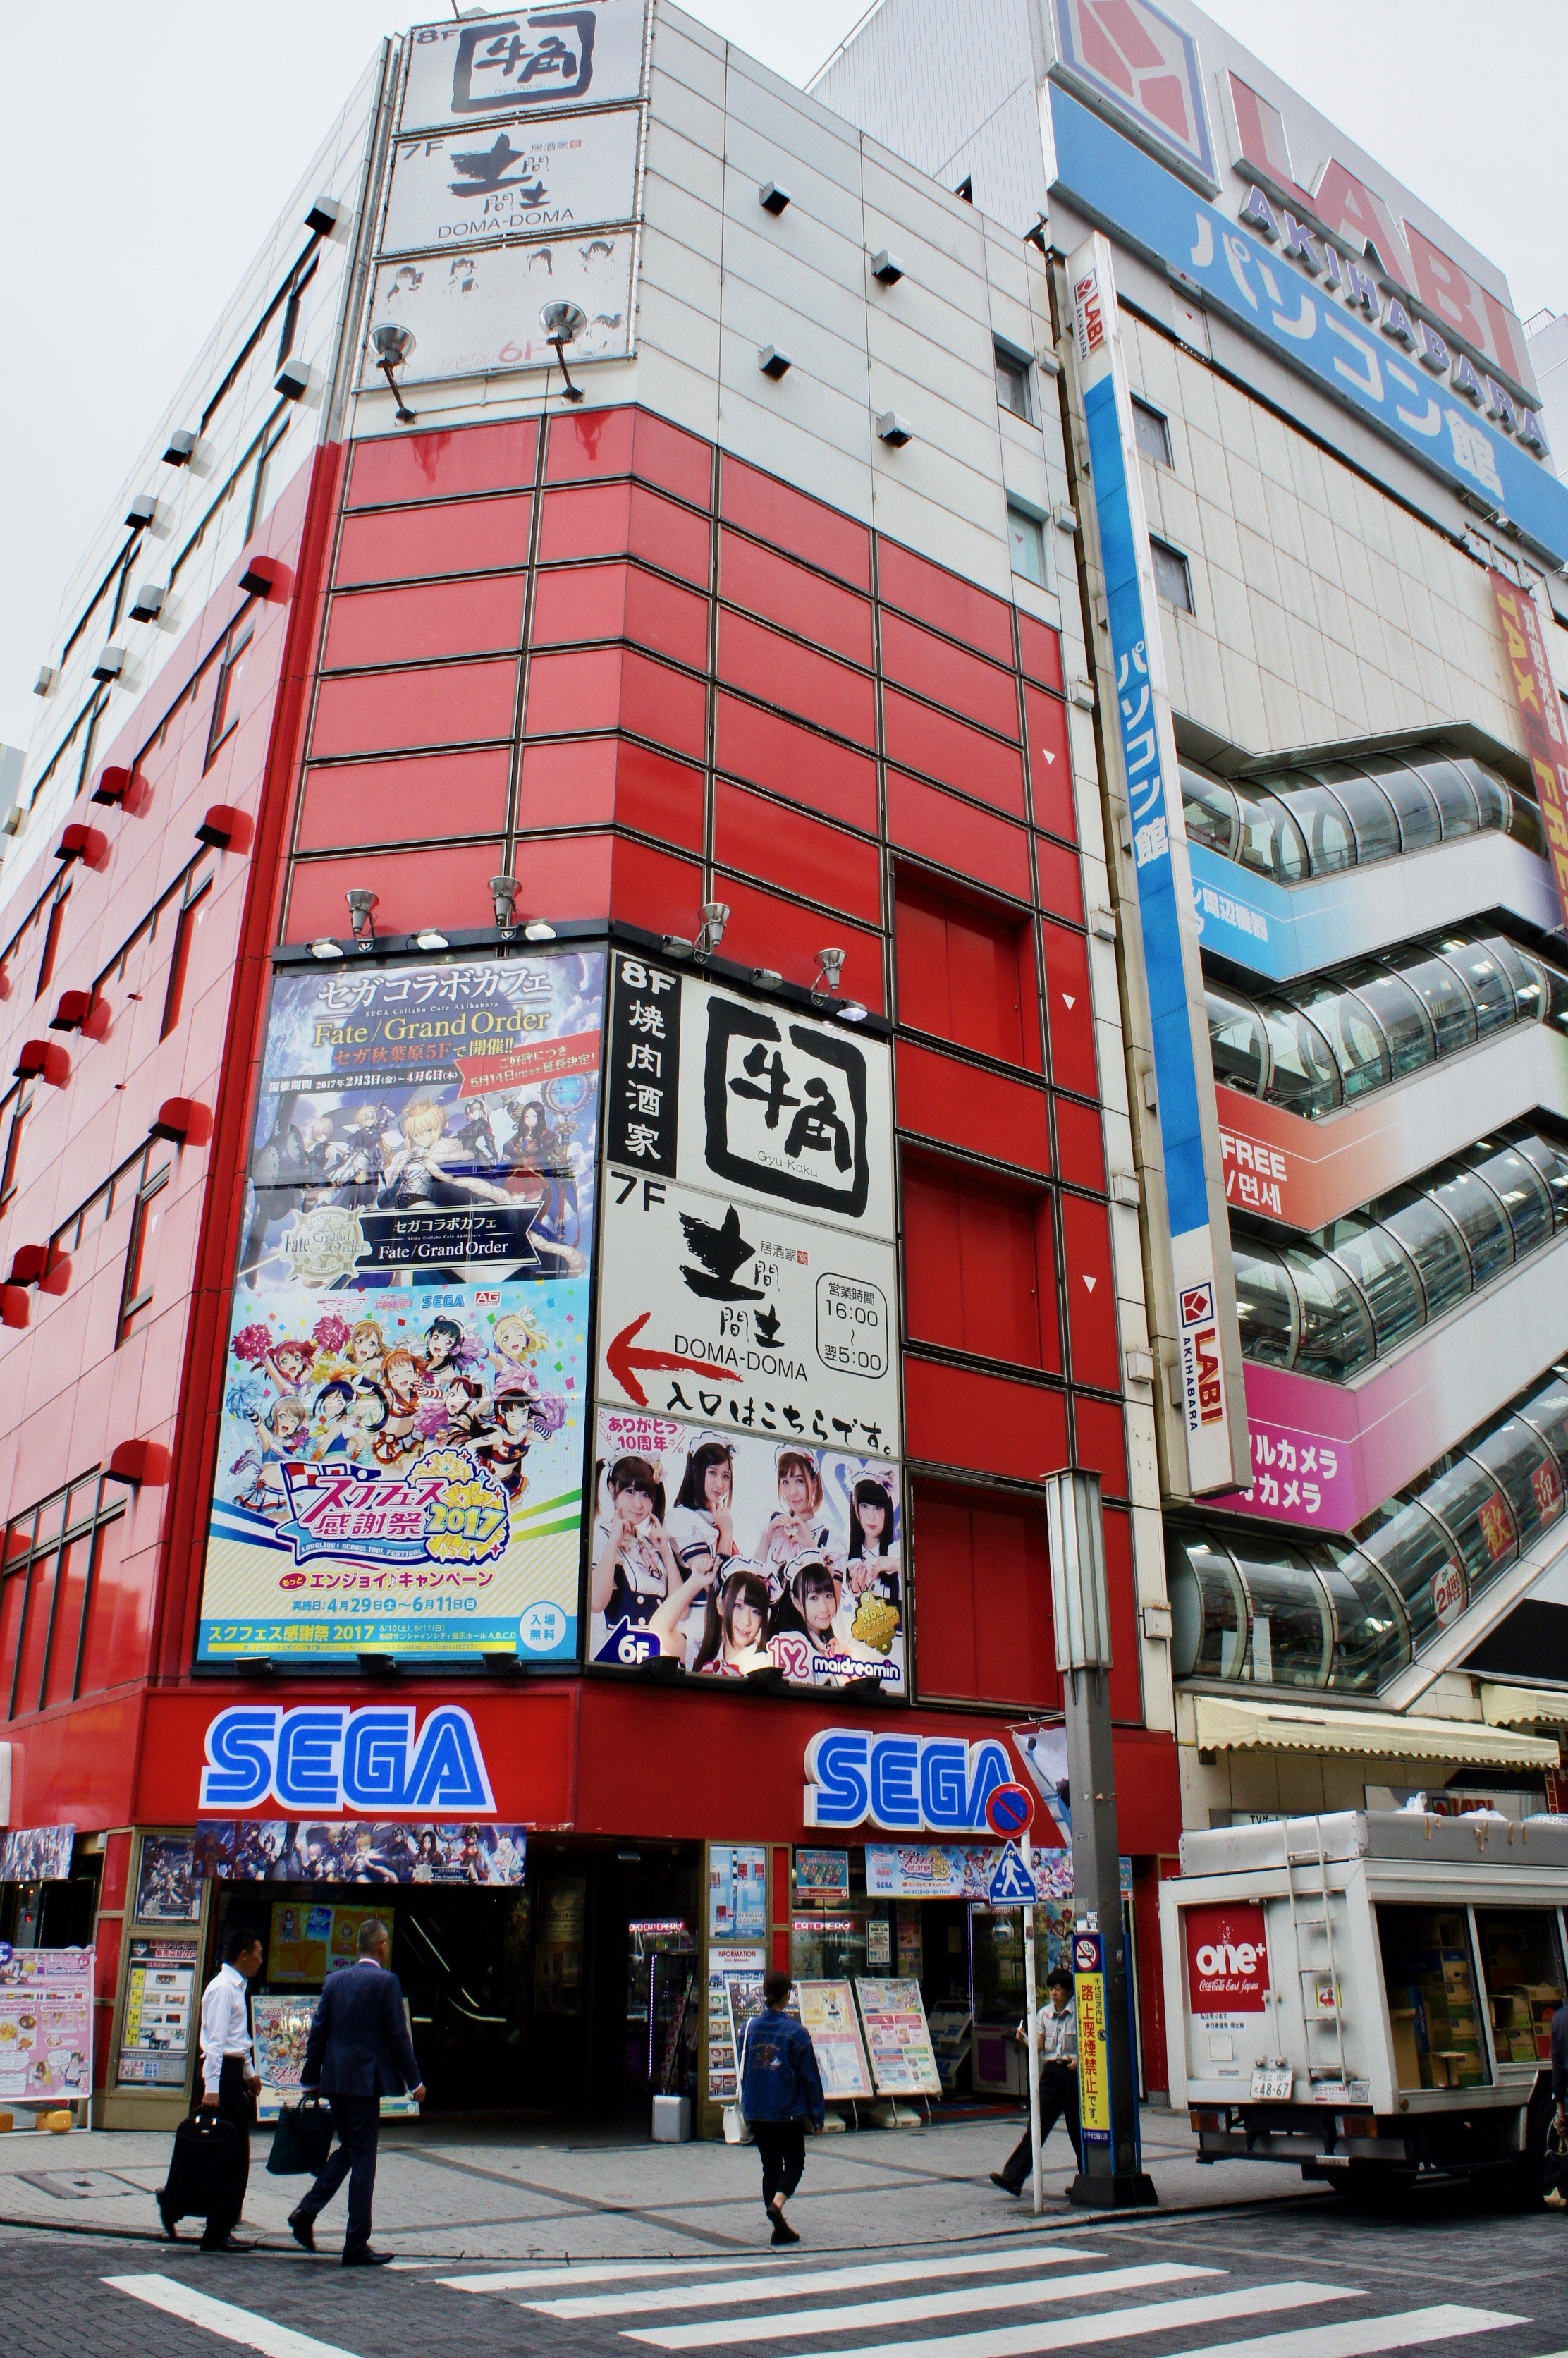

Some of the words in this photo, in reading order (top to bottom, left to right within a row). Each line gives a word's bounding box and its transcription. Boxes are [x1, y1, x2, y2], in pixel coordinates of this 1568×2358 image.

[416, 29, 460, 45] 8F
[474, 35, 577, 84] 牛角
[400, 140, 445, 161] 7F
[438, 209, 575, 239] DOMA-DOMA
[1229, 68, 1523, 386] LABI
[1076, 307, 1087, 361] AKIHABARA
[1084, 293, 1105, 350] LABI
[1245, 185, 1550, 457] AKIHABARA
[1192, 213, 1505, 501] パソコン館
[1497, 592, 1540, 714] TAX
[1117, 640, 1168, 868] パソコン館
[1533, 757, 1568, 924] FRE
[319, 968, 551, 1010] セガコラボカフェ
[621, 961, 677, 995] 8F
[365, 1009, 389, 1018] SEGA
[393, 1006, 427, 1015] Collabo
[430, 1004, 450, 1013] Cafe
[453, 1001, 499, 1011] Akihabara
[471, 1009, 550, 1033] Order
[499, 1045, 568, 1068] ご好評につき
[269, 1080, 313, 1093] 開催期間
[625, 999, 666, 1160] 焼肉酒家
[728, 1042, 852, 1173] 牛角
[757, 1151, 819, 1178] Gyu-Kaku
[1220, 1132, 1288, 1182] FREE
[611, 1171, 666, 1212] 7F
[312, 1229, 350, 1242] Grand
[394, 1217, 497, 1233] セガコラボカフェ
[285, 1233, 310, 1253] Fate
[329, 1240, 367, 1253] Order
[465, 1241, 508, 1255] Order
[761, 1240, 797, 1262] 居酒家
[422, 1294, 465, 1309] SEGA
[476, 1292, 501, 1302] AG
[828, 1281, 875, 1306] 営業時間
[826, 1300, 878, 1327] 16:00
[675, 1334, 808, 1382] DOMA-DOMA
[824, 1345, 881, 1372] 翌5:00
[1183, 1337, 1198, 1431] AKIHABARA
[1195, 1327, 1223, 1427] LABI
[608, 1417, 679, 1434] ありがとう
[667, 1381, 892, 1456] 入口はこちらです。
[617, 1435, 668, 1453] 10周年
[302, 1478, 447, 1523] スクフェス
[314, 1511, 423, 1537] 感謝祭
[425, 1503, 509, 1541] 2017
[301, 1542, 340, 1553] LOVELIVE!
[342, 1543, 368, 1552] SCHOOL
[387, 1548, 423, 1557] FESTIVAL
[283, 1577, 303, 1587] もっと
[530, 1613, 556, 1626] 入場
[860, 1601, 886, 1624] No.1
[209, 1625, 329, 1642] スクフェス感謝祭
[333, 1625, 375, 1640] 2017
[379, 1631, 486, 1641] 池袋サンシャインシティ展示ホール
[529, 1629, 556, 1642] 無料
[618, 1634, 650, 1664] 6F
[814, 1655, 900, 1680] maidreamin
[198, 1705, 498, 1814] SEGA
[804, 1728, 1016, 1833] SEGA
[905, 1855, 936, 1867] スクフェス
[1225, 1979, 1239, 1991] East
[1239, 1979, 1258, 1994] Japan
[1094, 1977, 1103, 2024] 千代田区内は
[1081, 1985, 1098, 2125] 路上喫煙禁止です。
[1260, 2083, 1289, 2097] 48-67
[1087, 2132, 1109, 2141] 千代田区
